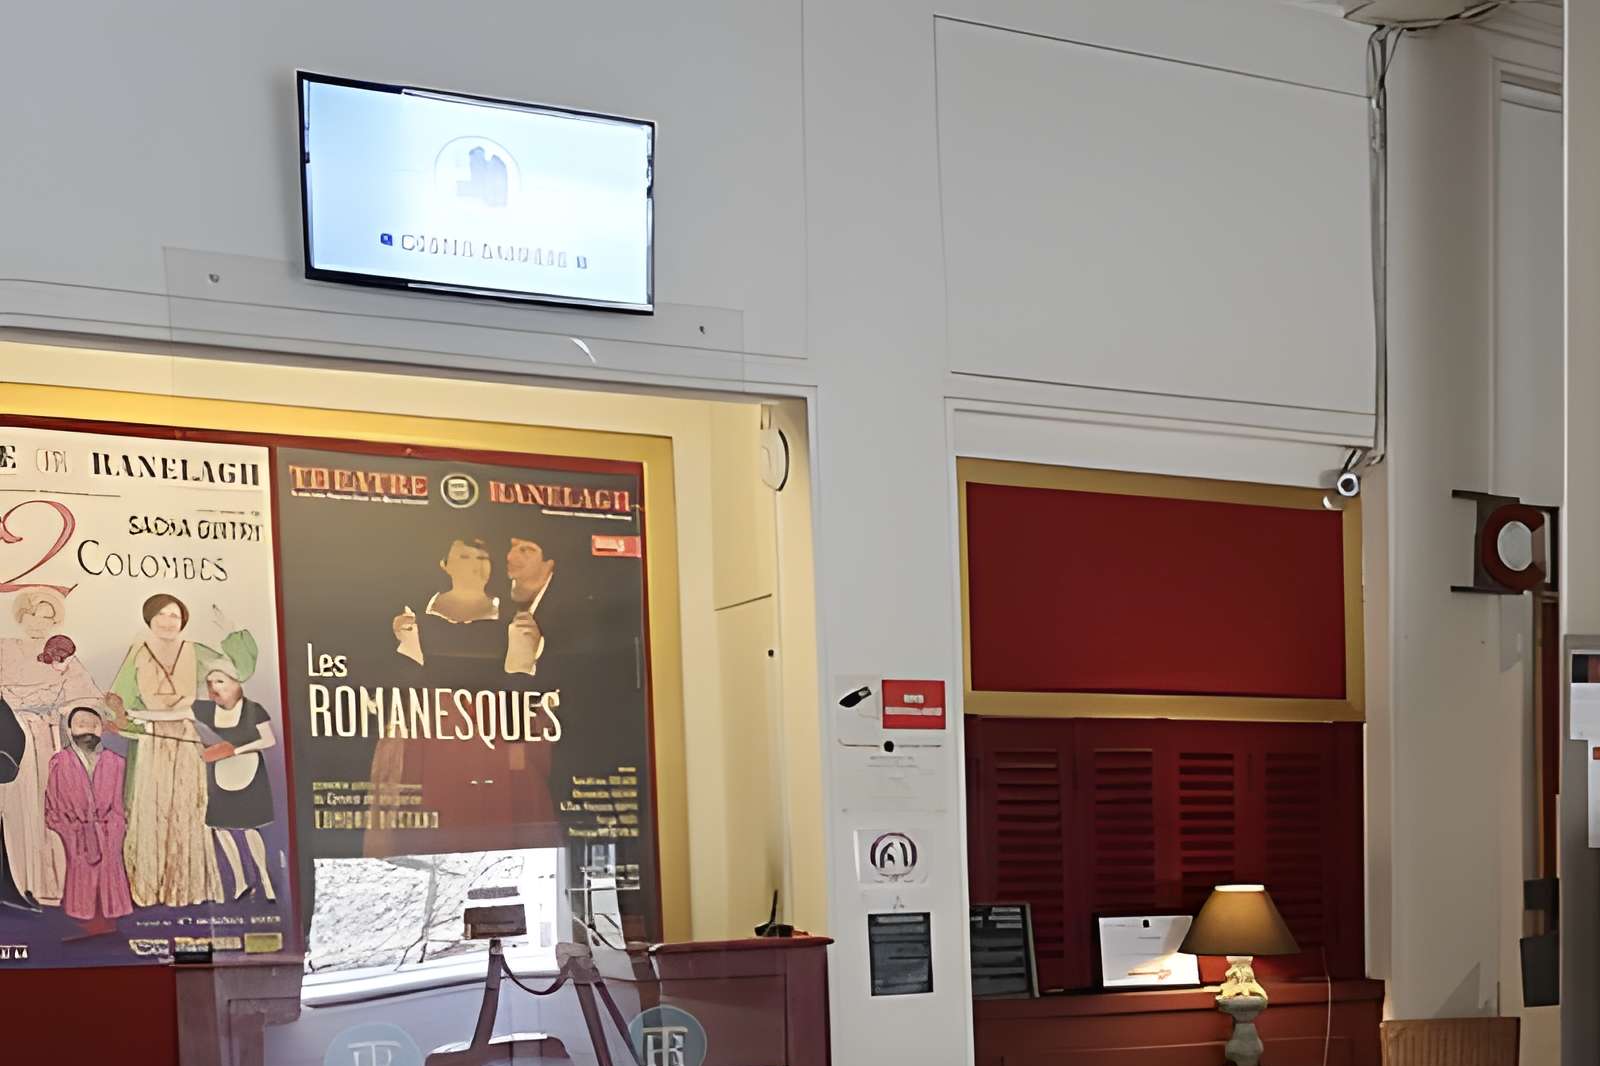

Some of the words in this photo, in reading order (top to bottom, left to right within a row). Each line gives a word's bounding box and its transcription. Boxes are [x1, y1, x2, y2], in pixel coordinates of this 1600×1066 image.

[0, 500, 78, 595] 2
[307, 643, 348, 678] Les
[308, 683, 562, 750] ROMANESQUES
